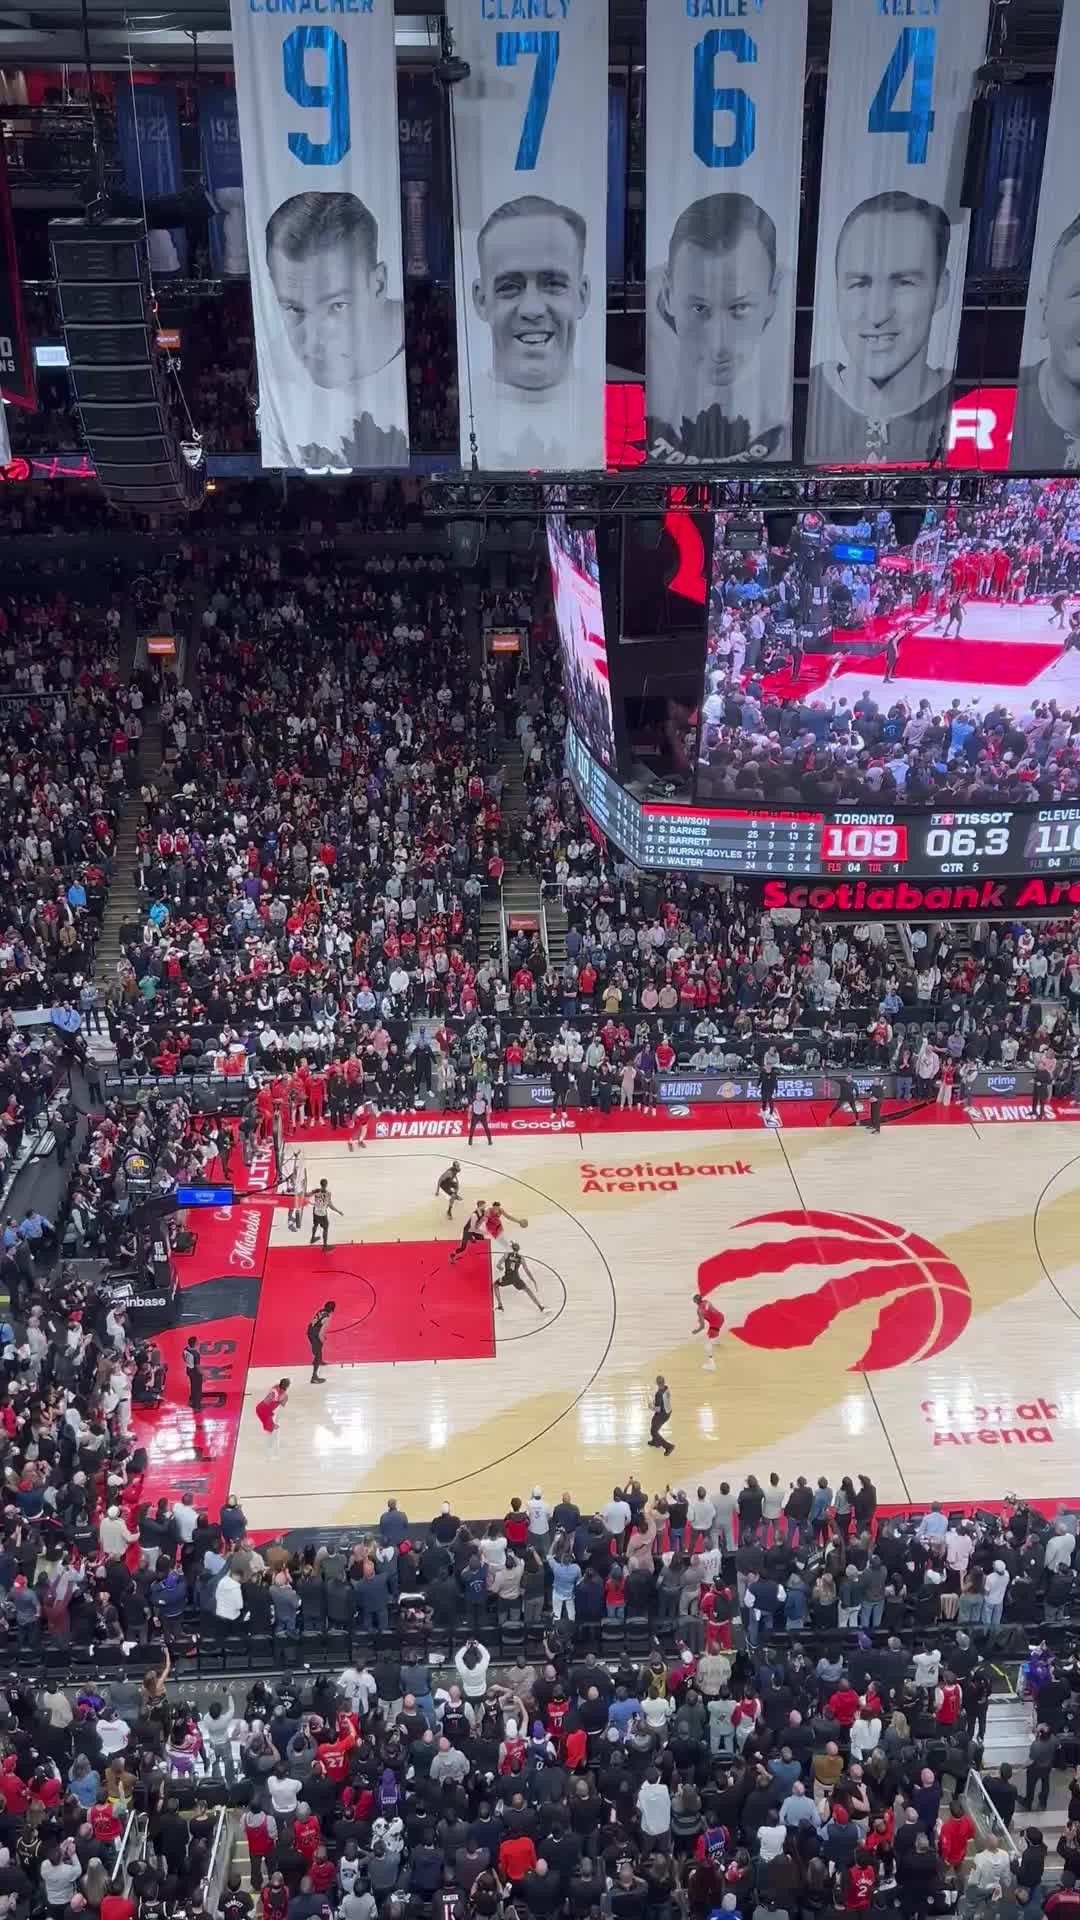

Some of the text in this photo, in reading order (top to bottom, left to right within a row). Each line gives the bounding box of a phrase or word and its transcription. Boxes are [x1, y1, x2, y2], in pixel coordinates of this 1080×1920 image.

[283, 25, 351, 165] 9
[496, 31, 560, 170] 7
[693, 28, 758, 168] 6
[868, 27, 936, 164] 4
[671, 816, 710, 826] LAWSON
[834, 814, 894, 824] TORONTO
[955, 812, 1013, 824] TISSOT
[670, 826, 707, 835] BARNES
[669, 836, 711, 846] BARRETT
[828, 829, 898, 856] 109
[926, 828, 1009, 856] 06.3
[668, 847, 742, 859] MURRAY-BOYLES
[667, 857, 703, 866] WALTER
[848, 863, 860, 872] 04
[941, 862, 979, 872] QTR 5
[1048, 858, 1060, 867] 04
[763, 880, 1006, 910] Scotiabank
[988, 1076, 1016, 1087] prime
[668, 1083, 702, 1096] PLAYOFFS
[390, 1120, 463, 1136] PLAYOFFS
[511, 1119, 576, 1130] Google
[580, 1160, 755, 1178] Scotiabank
[582, 1180, 679, 1193] Arena
[229, 1210, 262, 1268] Michelob
[328, 1756, 344, 1768] 27
[857, 1885, 868, 1897] 2
